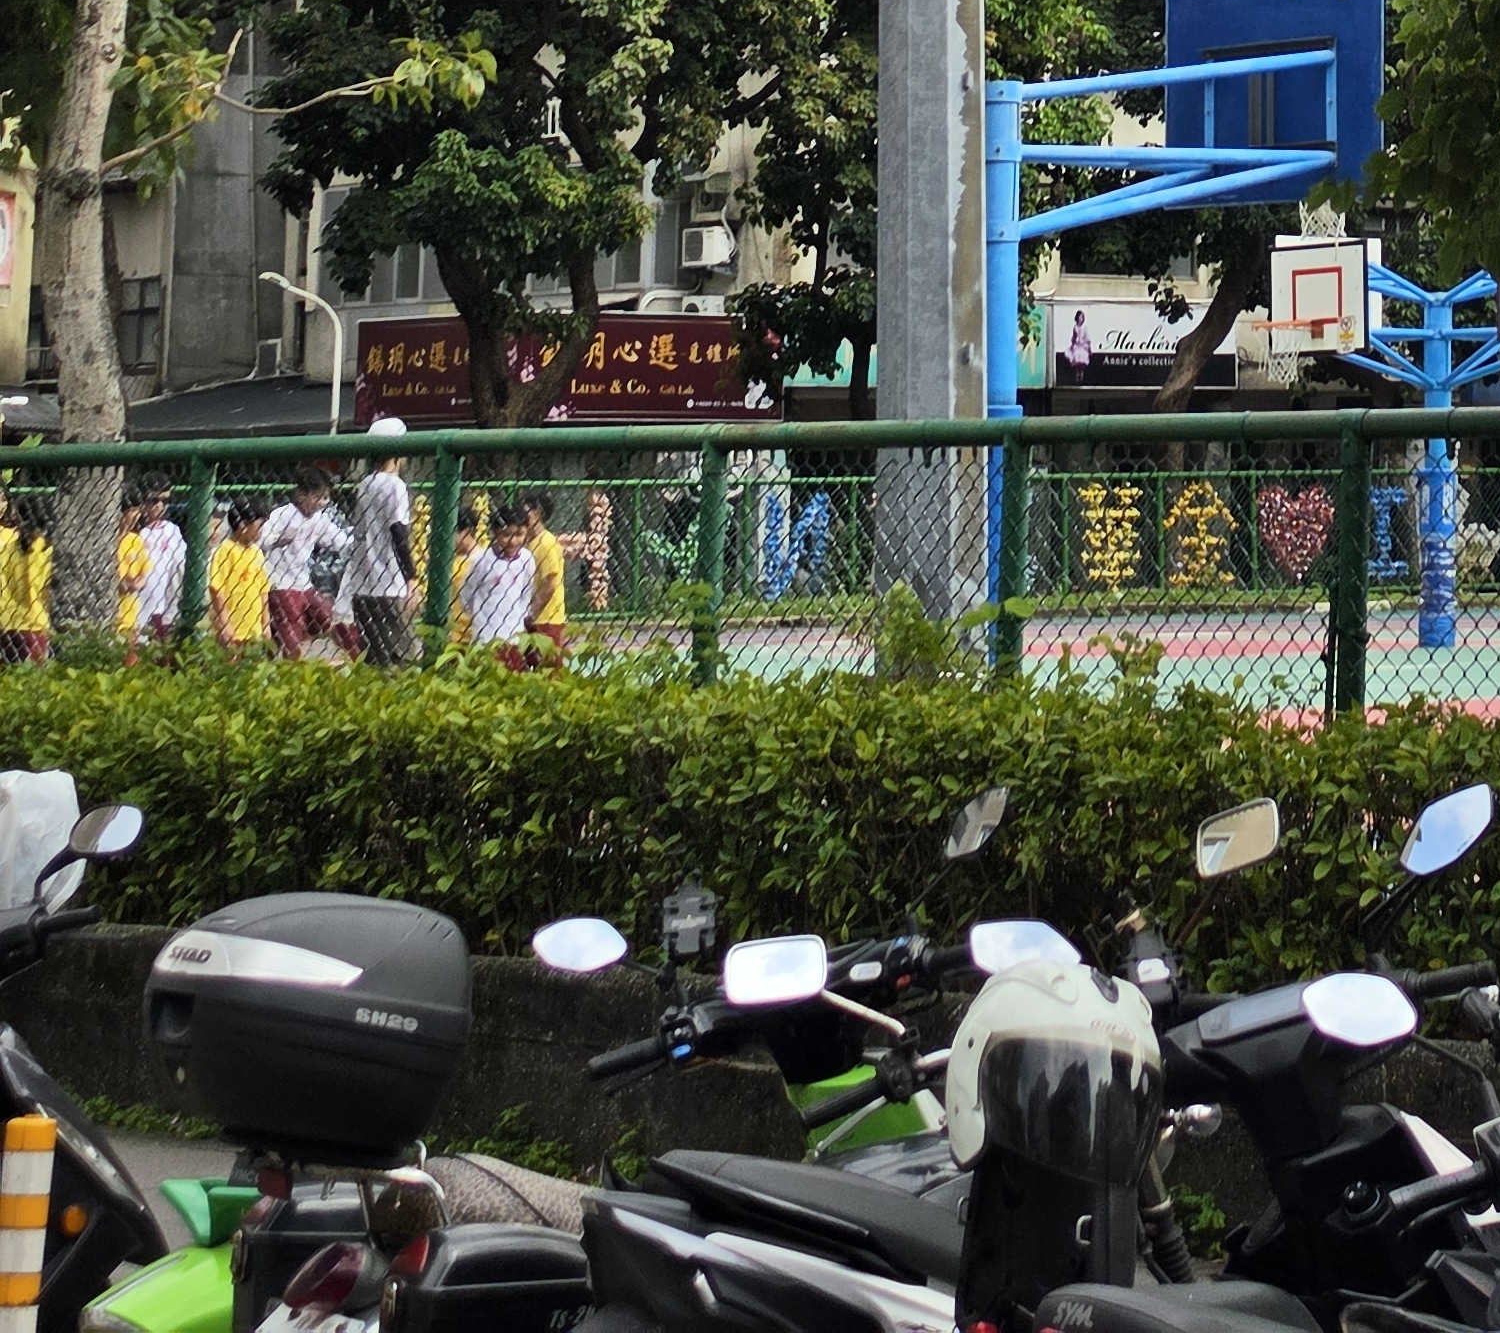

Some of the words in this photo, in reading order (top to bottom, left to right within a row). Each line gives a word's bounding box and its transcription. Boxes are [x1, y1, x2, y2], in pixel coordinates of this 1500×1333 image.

[1098, 330, 1137, 351] Ma
[1102, 355, 1136, 366] Annie's
[609, 378, 622, 395] &
[168, 945, 213, 964] SHAD
[355, 1007, 419, 1033] SH29
[1052, 1300, 1094, 1331] SYM
